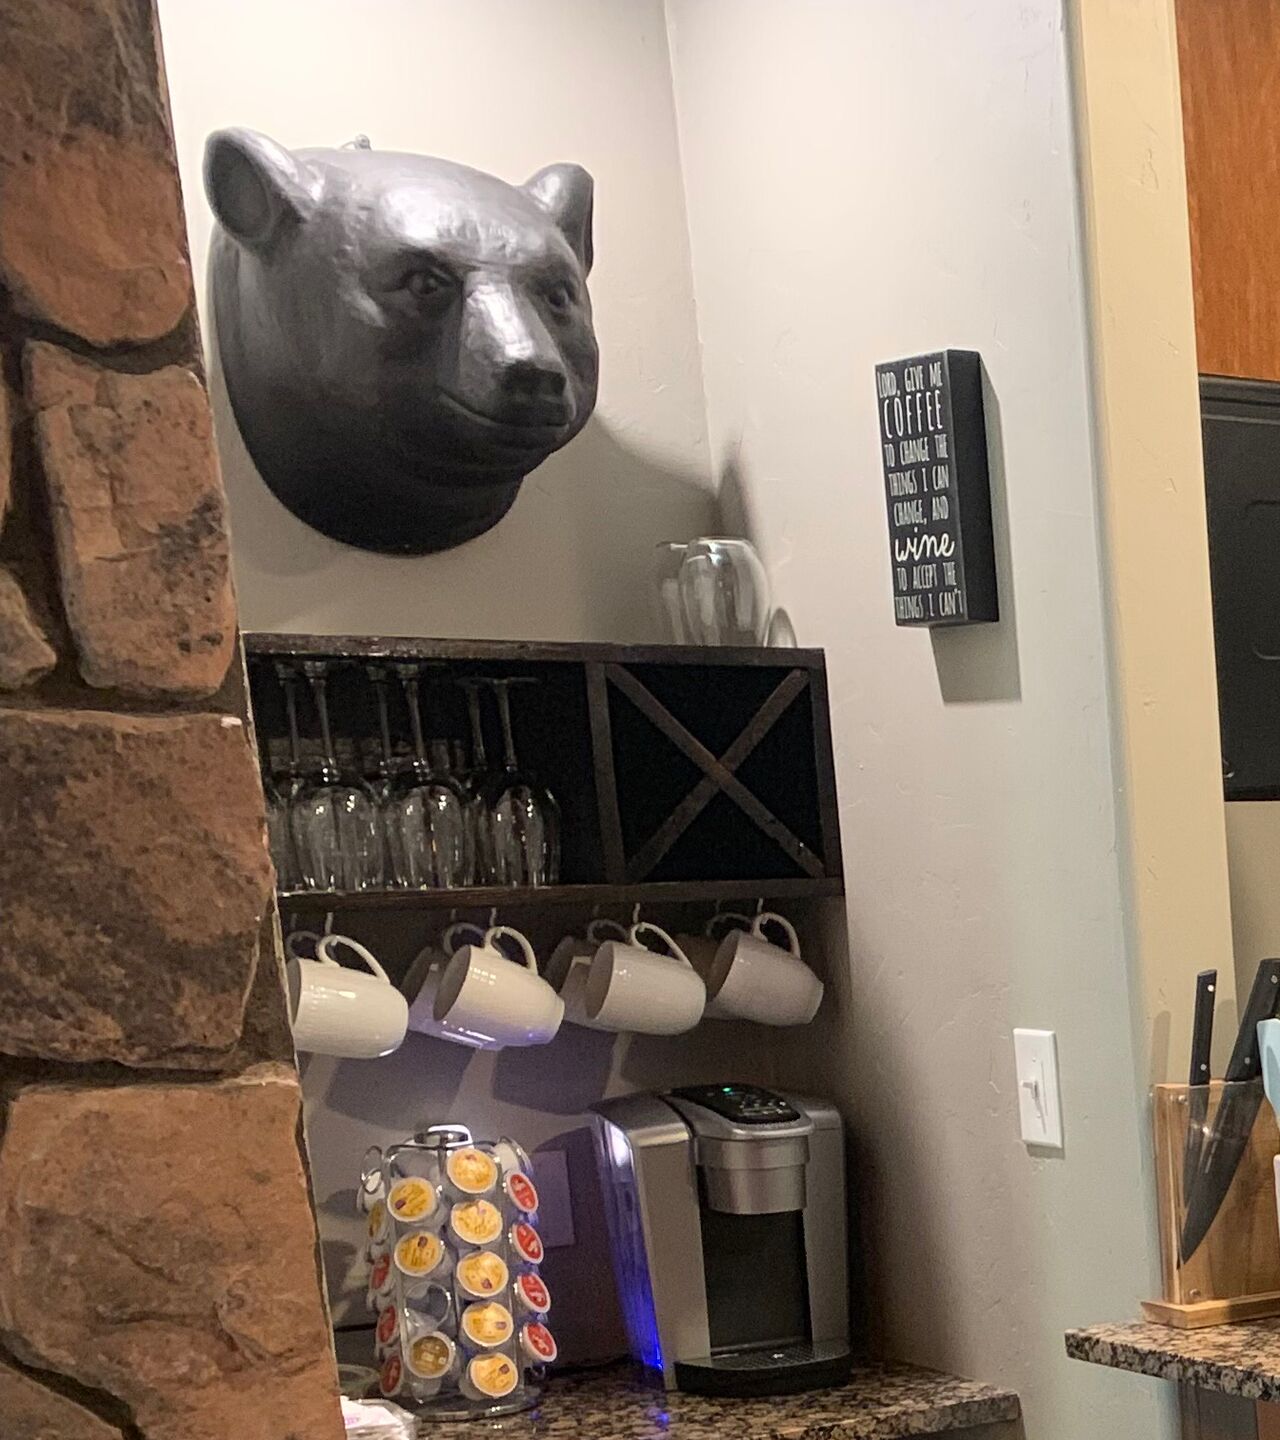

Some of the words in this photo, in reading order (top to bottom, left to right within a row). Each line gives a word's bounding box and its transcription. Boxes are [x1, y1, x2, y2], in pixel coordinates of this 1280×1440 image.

[904, 365, 924, 392] GIVE
[929, 361, 943, 387] ME
[883, 389, 943, 439] COFFEE
[884, 443, 895, 467] TO
[900, 436, 930, 465] CHANGE
[935, 433, 948, 458] THE
[888, 469, 917, 497] THINGS
[921, 467, 928, 492] I
[932, 464, 949, 491] CAN
[893, 499, 927, 527] CHANGE,
[932, 495, 949, 521] AND
[894, 526, 955, 562] wine
[896, 567, 907, 591] TO
[912, 563, 938, 589] ACCEPT
[942, 561, 957, 586] THE
[895, 594, 924, 620] THINGS
[928, 593, 935, 617] I
[938, 588, 963, 617] CAN'T
